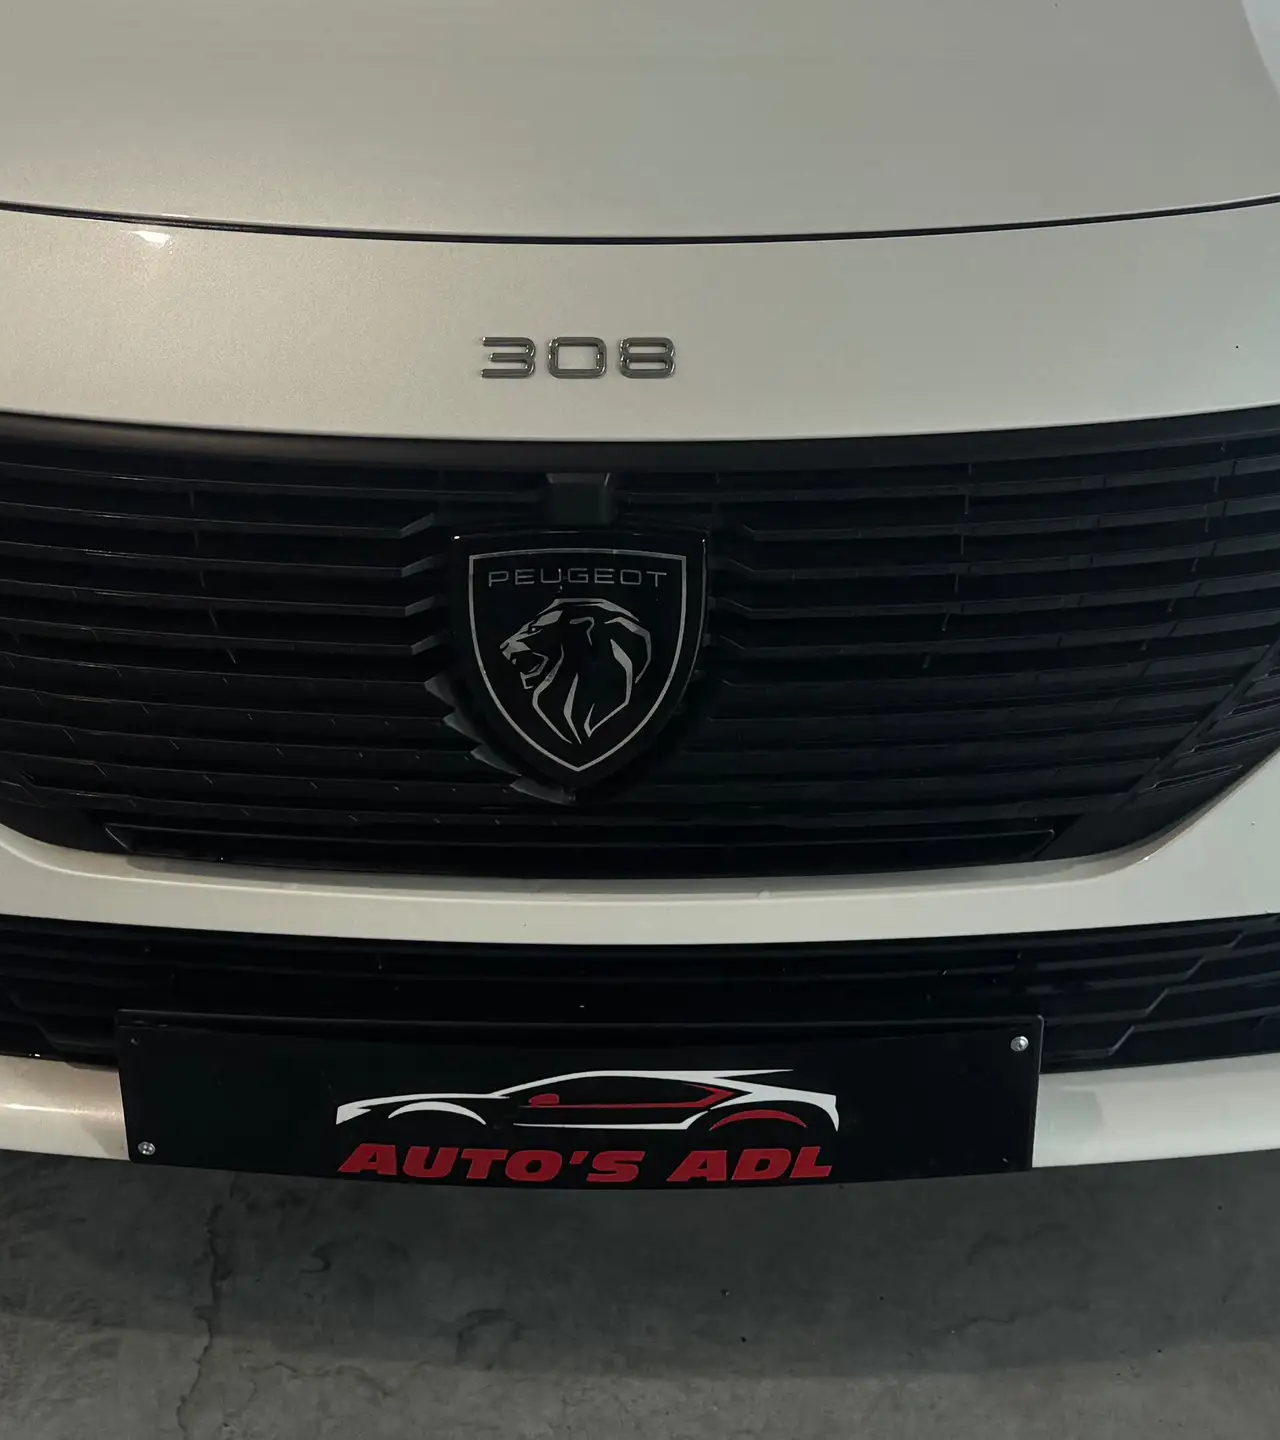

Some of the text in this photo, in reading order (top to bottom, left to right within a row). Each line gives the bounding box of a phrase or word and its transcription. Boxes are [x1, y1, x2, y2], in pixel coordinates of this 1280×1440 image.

[480, 336, 676, 379] 308
[487, 567, 668, 588] PEUGEOT
[337, 1142, 833, 1183] AUTO'S ADL
